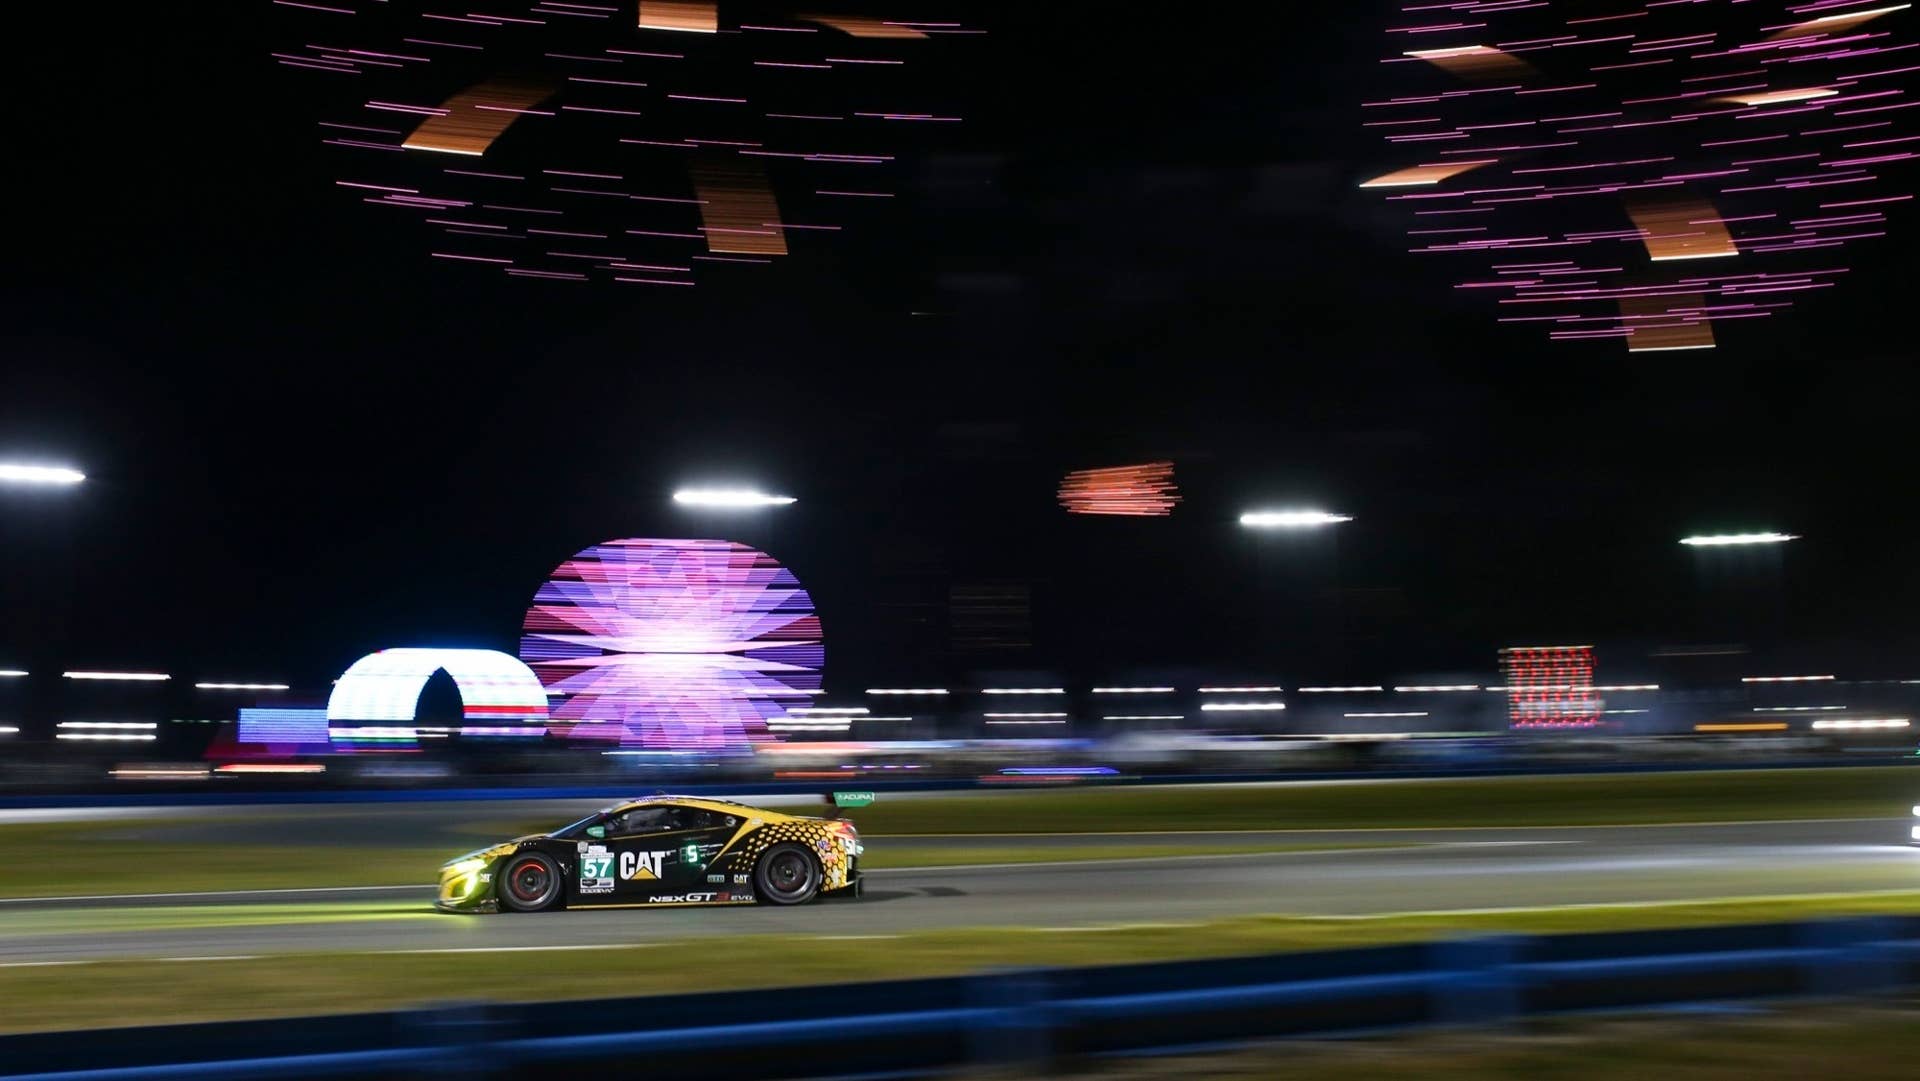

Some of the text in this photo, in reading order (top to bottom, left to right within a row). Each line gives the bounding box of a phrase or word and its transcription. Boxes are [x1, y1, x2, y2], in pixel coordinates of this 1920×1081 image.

[583, 859, 612, 878] 57
[620, 851, 665, 880] CAT
[733, 874, 749, 883] CAT
[649, 895, 685, 903] NSX
